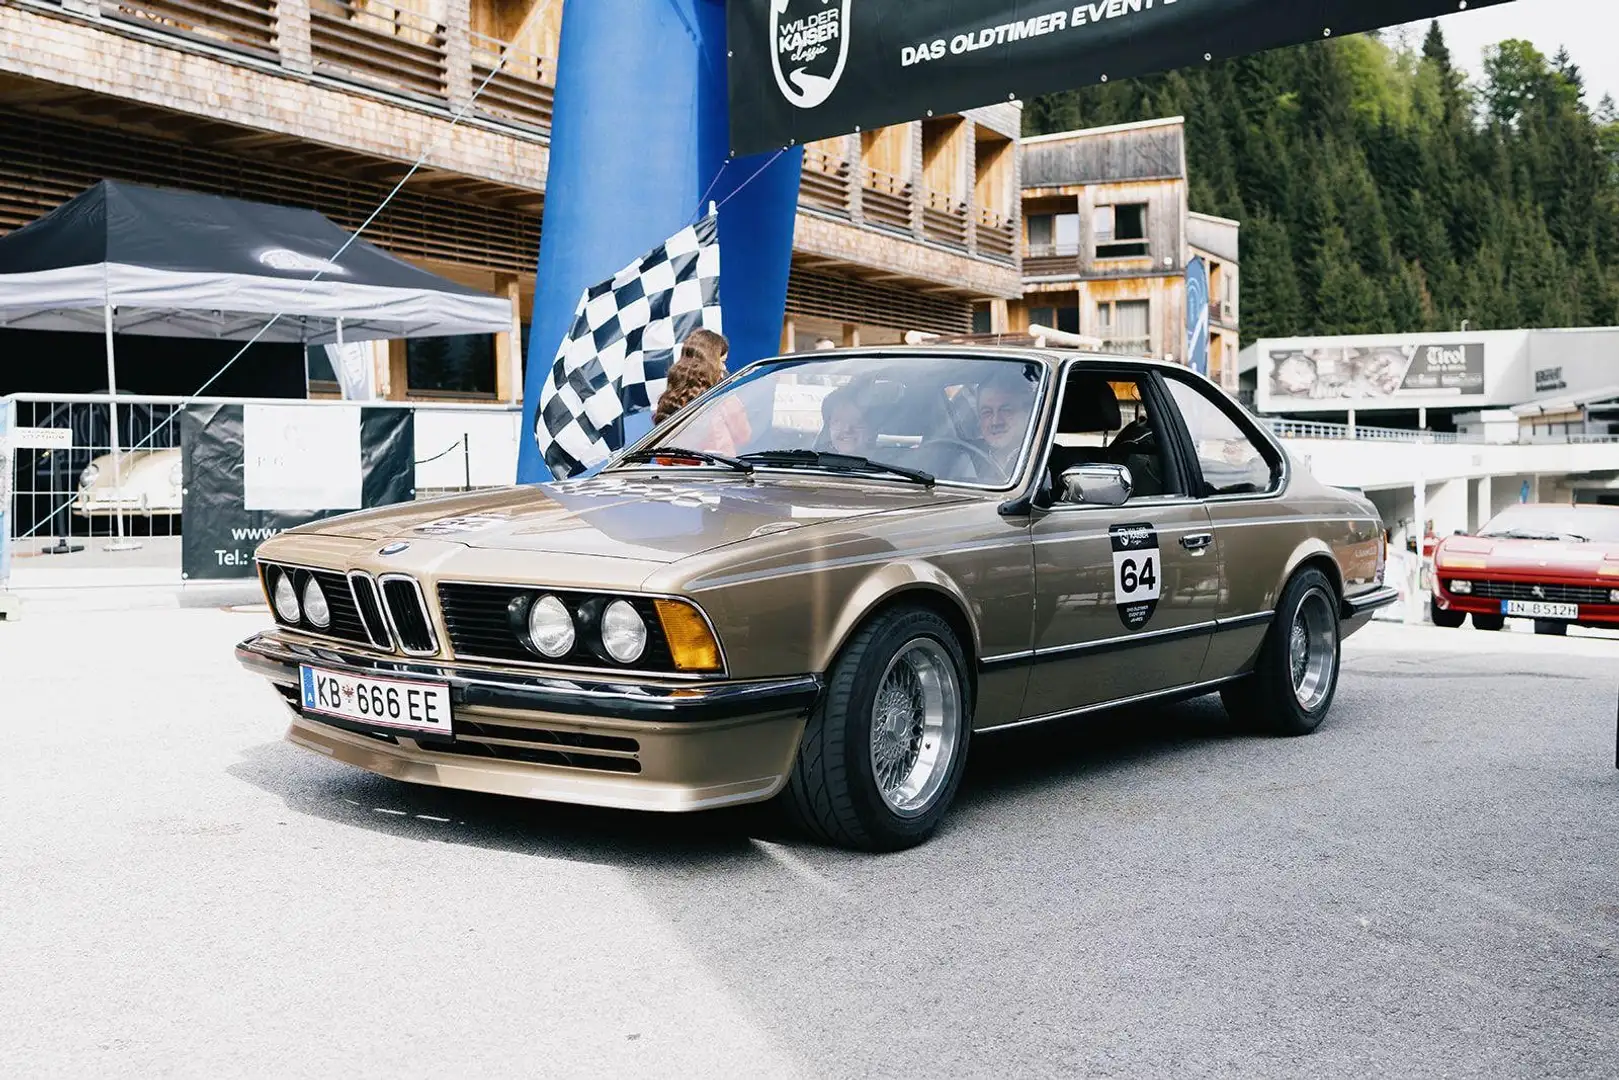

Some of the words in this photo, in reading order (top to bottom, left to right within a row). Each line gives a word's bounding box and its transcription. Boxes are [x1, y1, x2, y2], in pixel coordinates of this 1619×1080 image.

[779, 9, 839, 36] WILDER
[779, 21, 839, 53] KAISER
[901, 39, 947, 67] DAS
[949, 10, 1068, 55] OLDTIMER
[1426, 345, 1466, 365] Tirol
[213, 548, 248, 566] Tel.:
[1120, 556, 1156, 594] 64
[317, 675, 341, 708] KB
[356, 683, 400, 719] 666
[407, 689, 439, 723] EE
